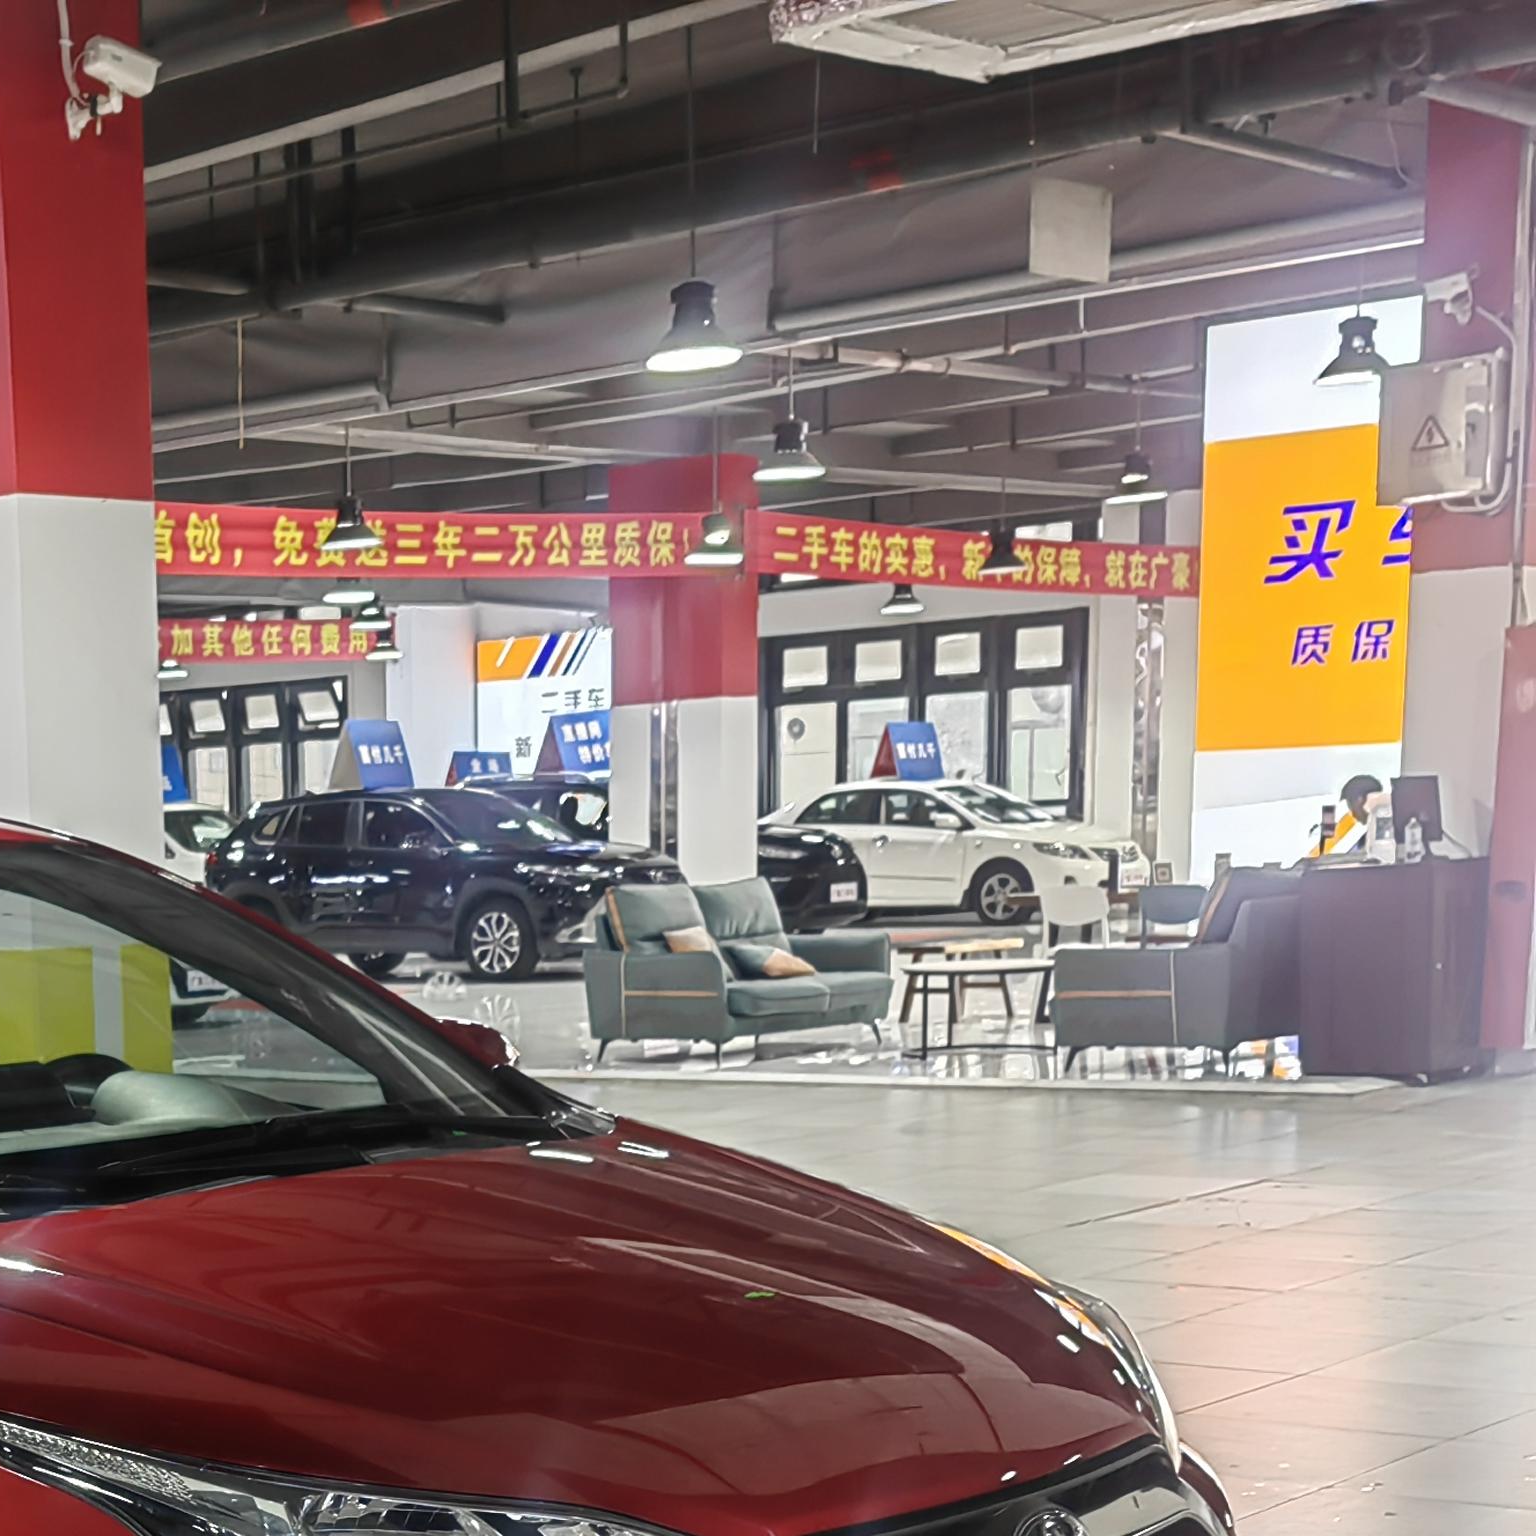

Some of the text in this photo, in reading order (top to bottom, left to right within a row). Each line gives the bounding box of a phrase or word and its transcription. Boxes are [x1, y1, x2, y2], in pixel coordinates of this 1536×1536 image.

[158, 621, 370, 659] 加其他任何费用
[1291, 619, 1395, 666] 质保
